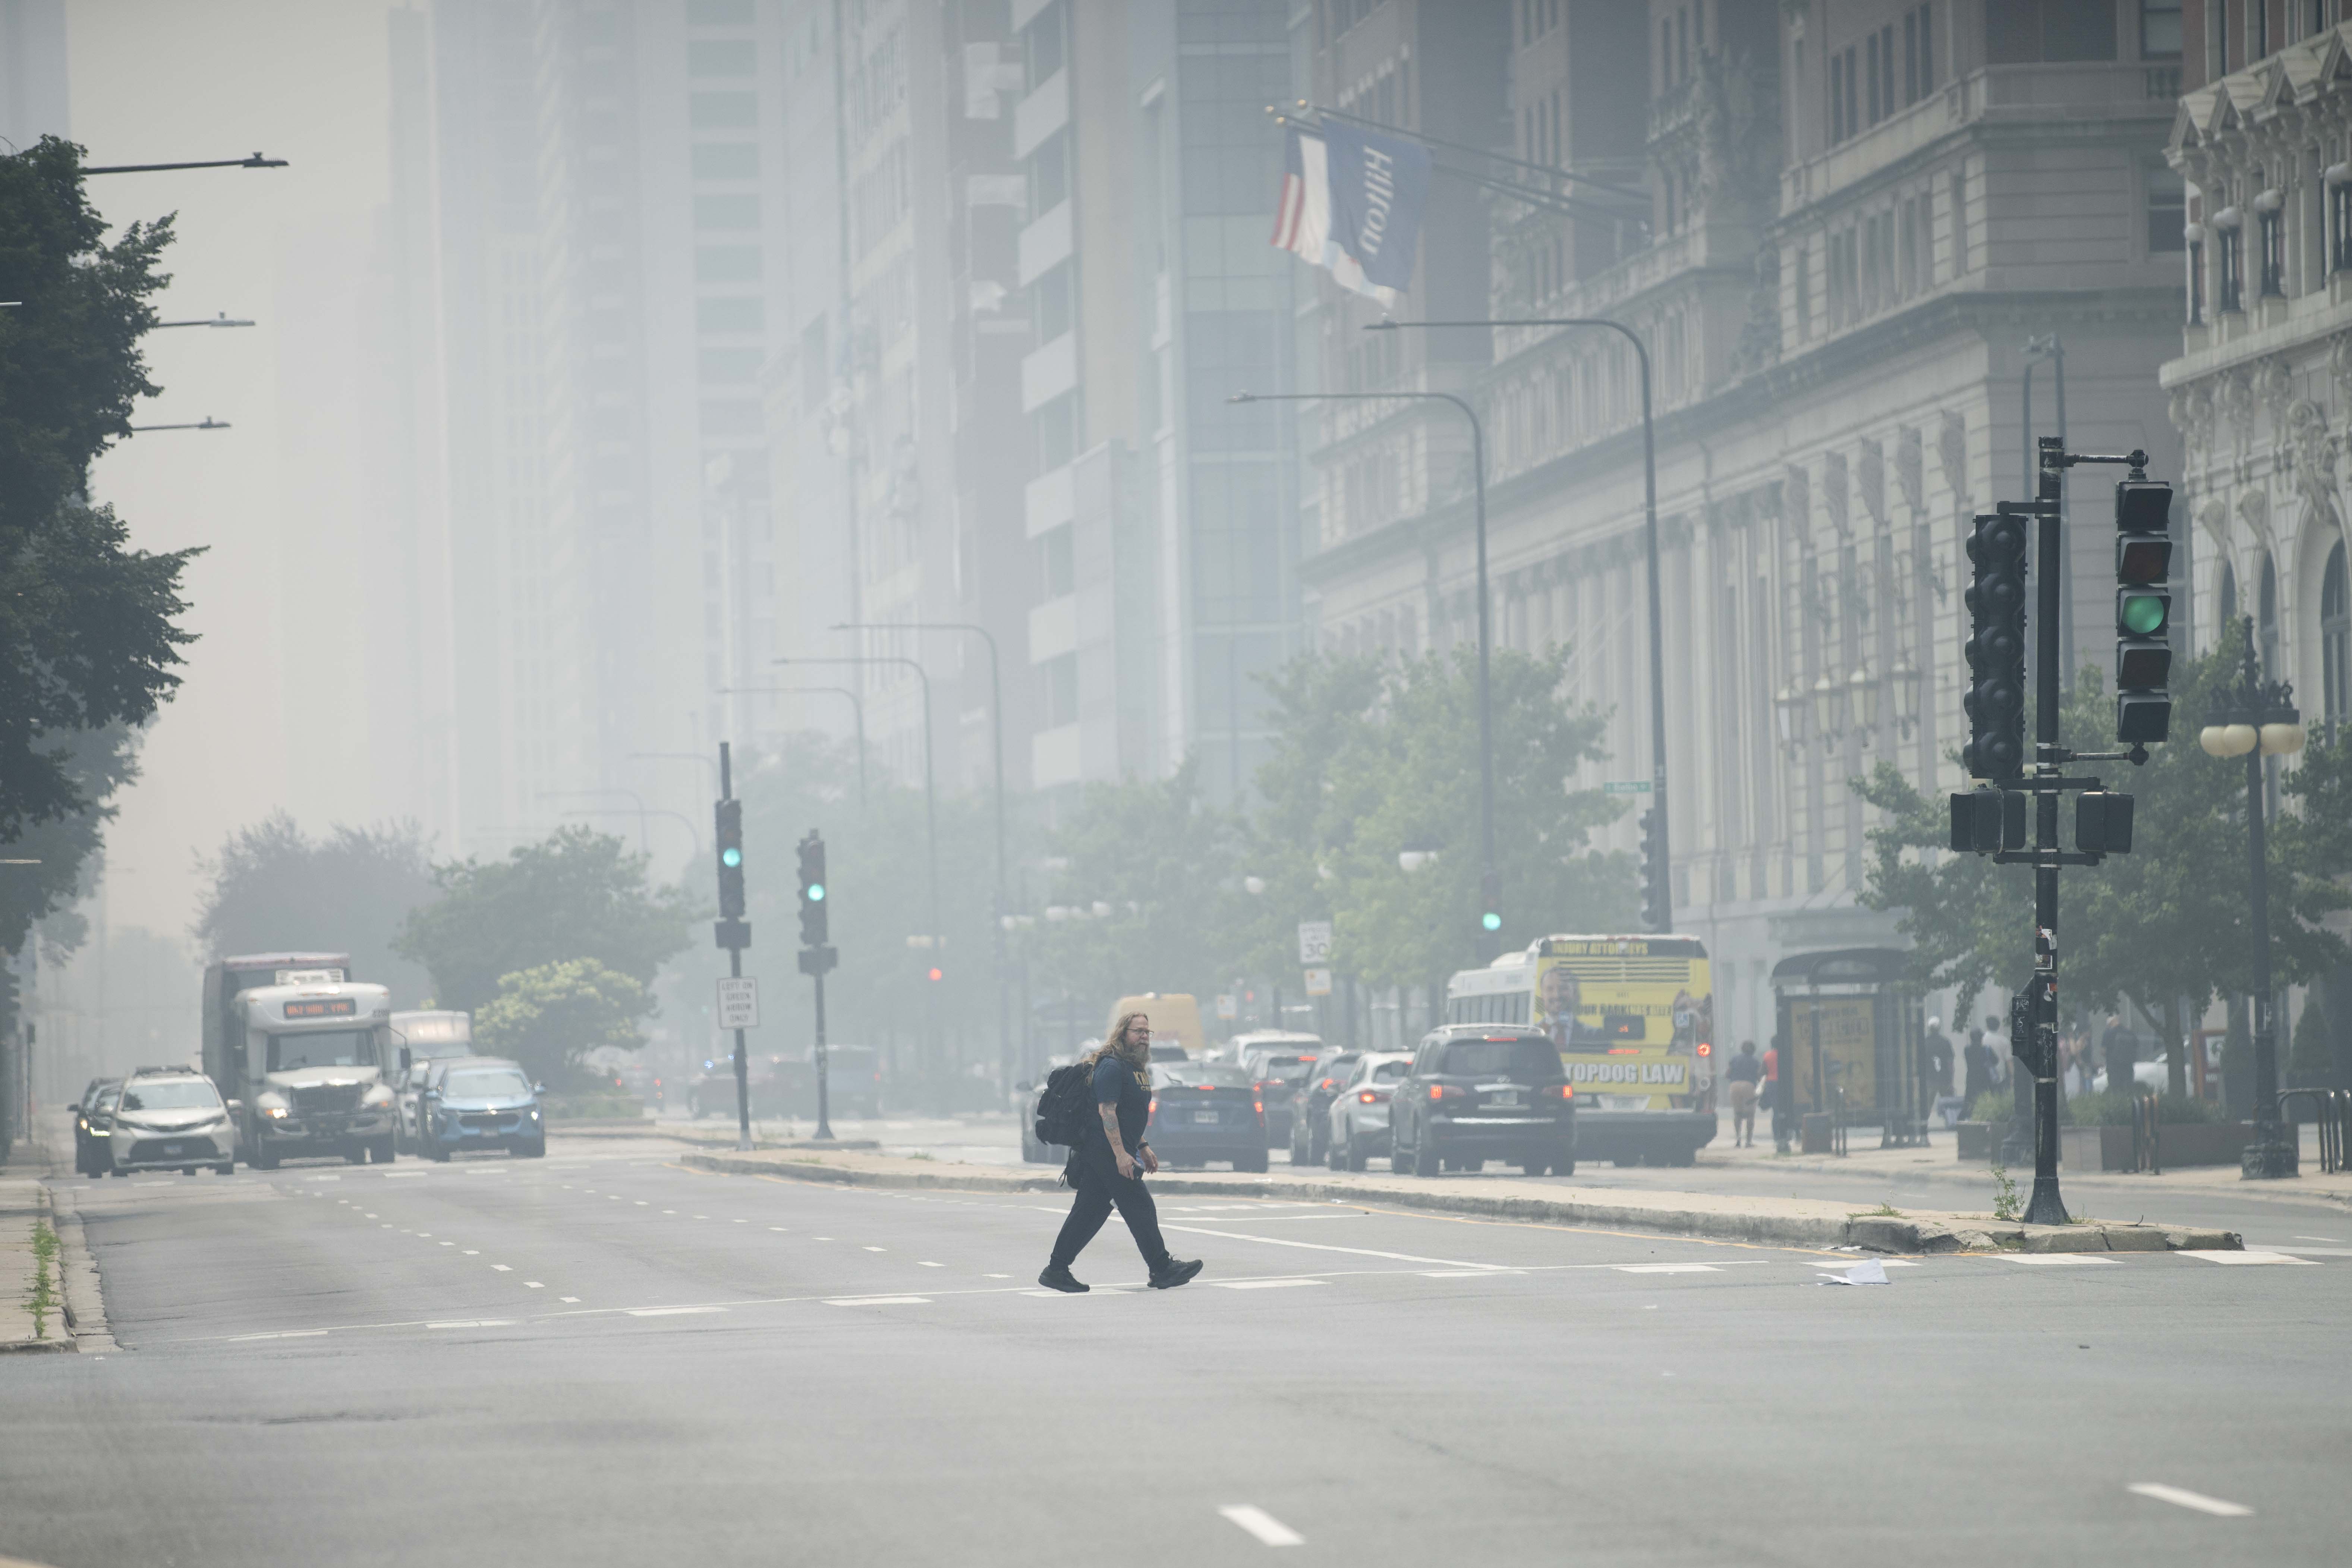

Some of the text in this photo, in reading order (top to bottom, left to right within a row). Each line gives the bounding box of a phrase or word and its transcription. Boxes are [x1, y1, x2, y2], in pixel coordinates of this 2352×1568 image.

[1358, 144, 1394, 255] Hilton
[1305, 942, 1329, 958] 30
[1552, 942, 1648, 955] INJURY ATTOEYS
[722, 981, 740, 991] LEFT
[725, 992, 751, 1001] GREEN
[725, 1003, 752, 1011] ARROW
[730, 1014, 749, 1022] ONLY
[1563, 1063, 1684, 1084] TOPDOG LAW
